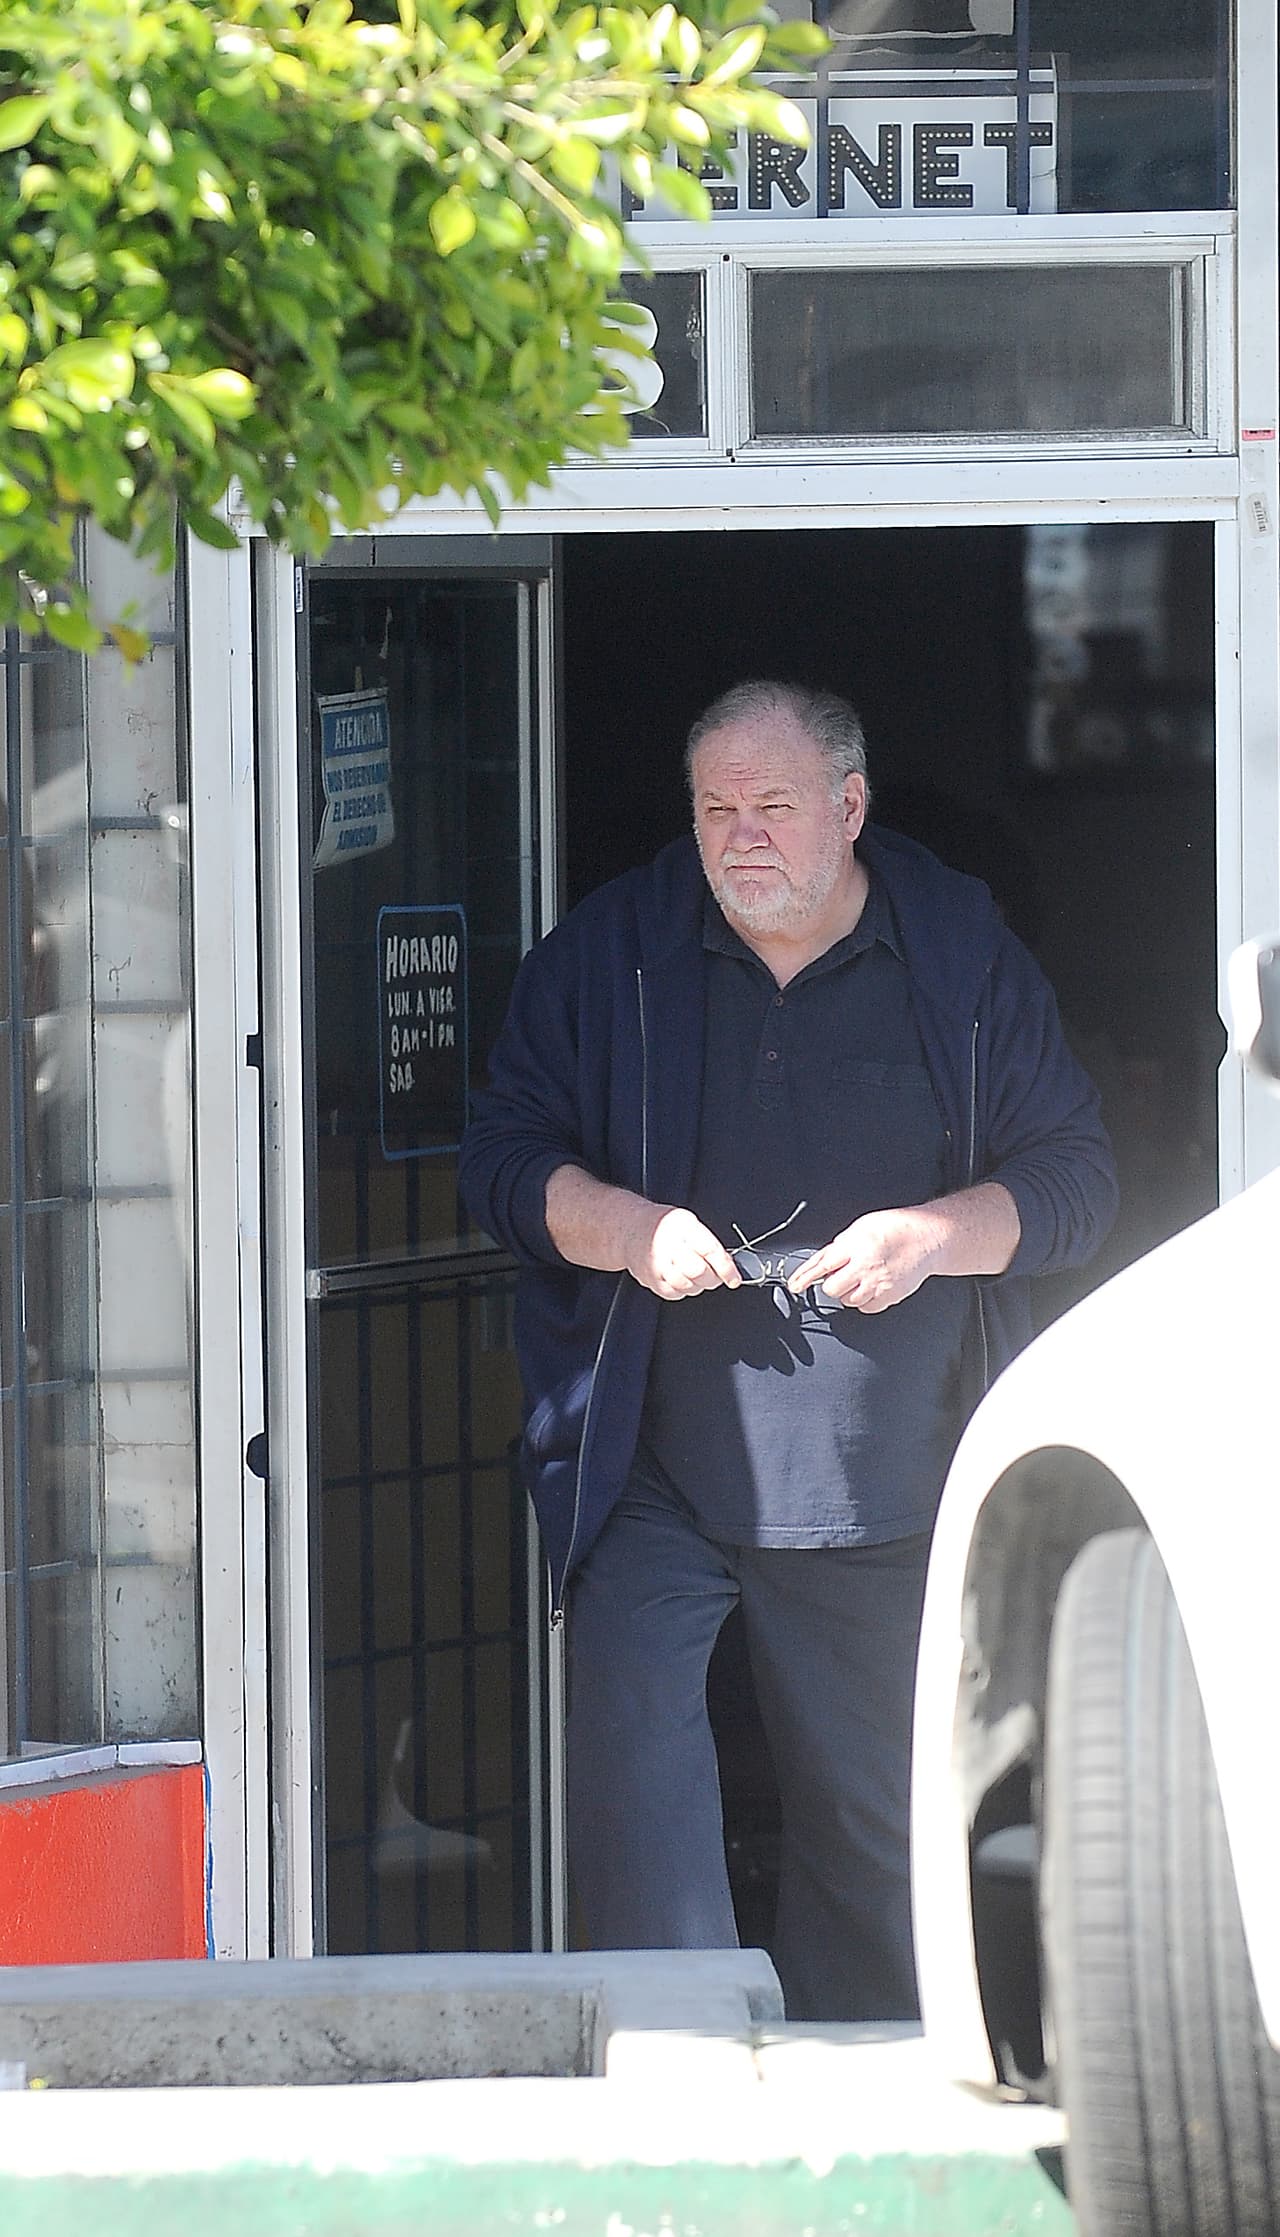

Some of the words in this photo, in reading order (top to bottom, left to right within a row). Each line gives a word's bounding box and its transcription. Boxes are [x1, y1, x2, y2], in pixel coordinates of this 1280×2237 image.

[621, 123, 1053, 211] ERNET
[385, 935, 458, 983] HORARIO
[416, 990, 425, 1016] A
